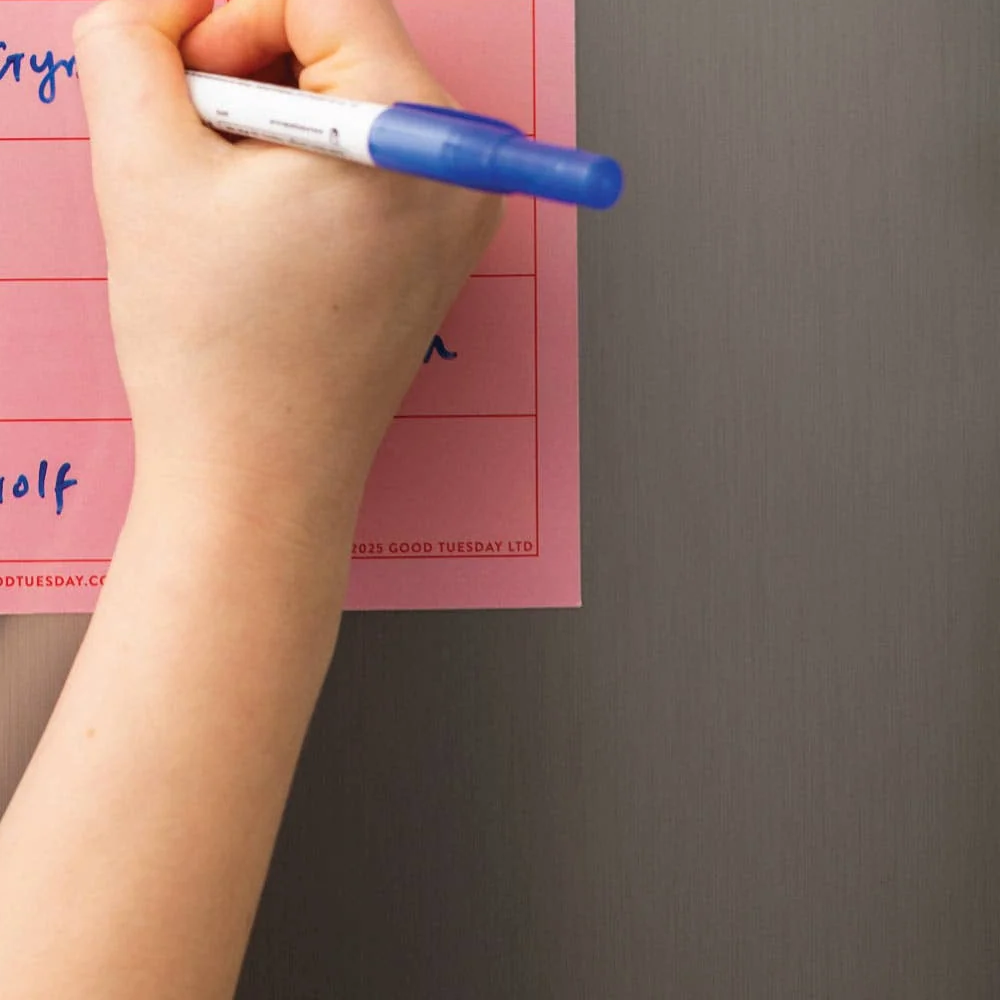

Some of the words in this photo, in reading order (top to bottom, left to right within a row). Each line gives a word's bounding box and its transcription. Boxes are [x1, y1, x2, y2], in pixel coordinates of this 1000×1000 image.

[388, 541, 433, 554] GOOD
[437, 540, 503, 553] TUESDAY
[508, 540, 533, 552] LTD
